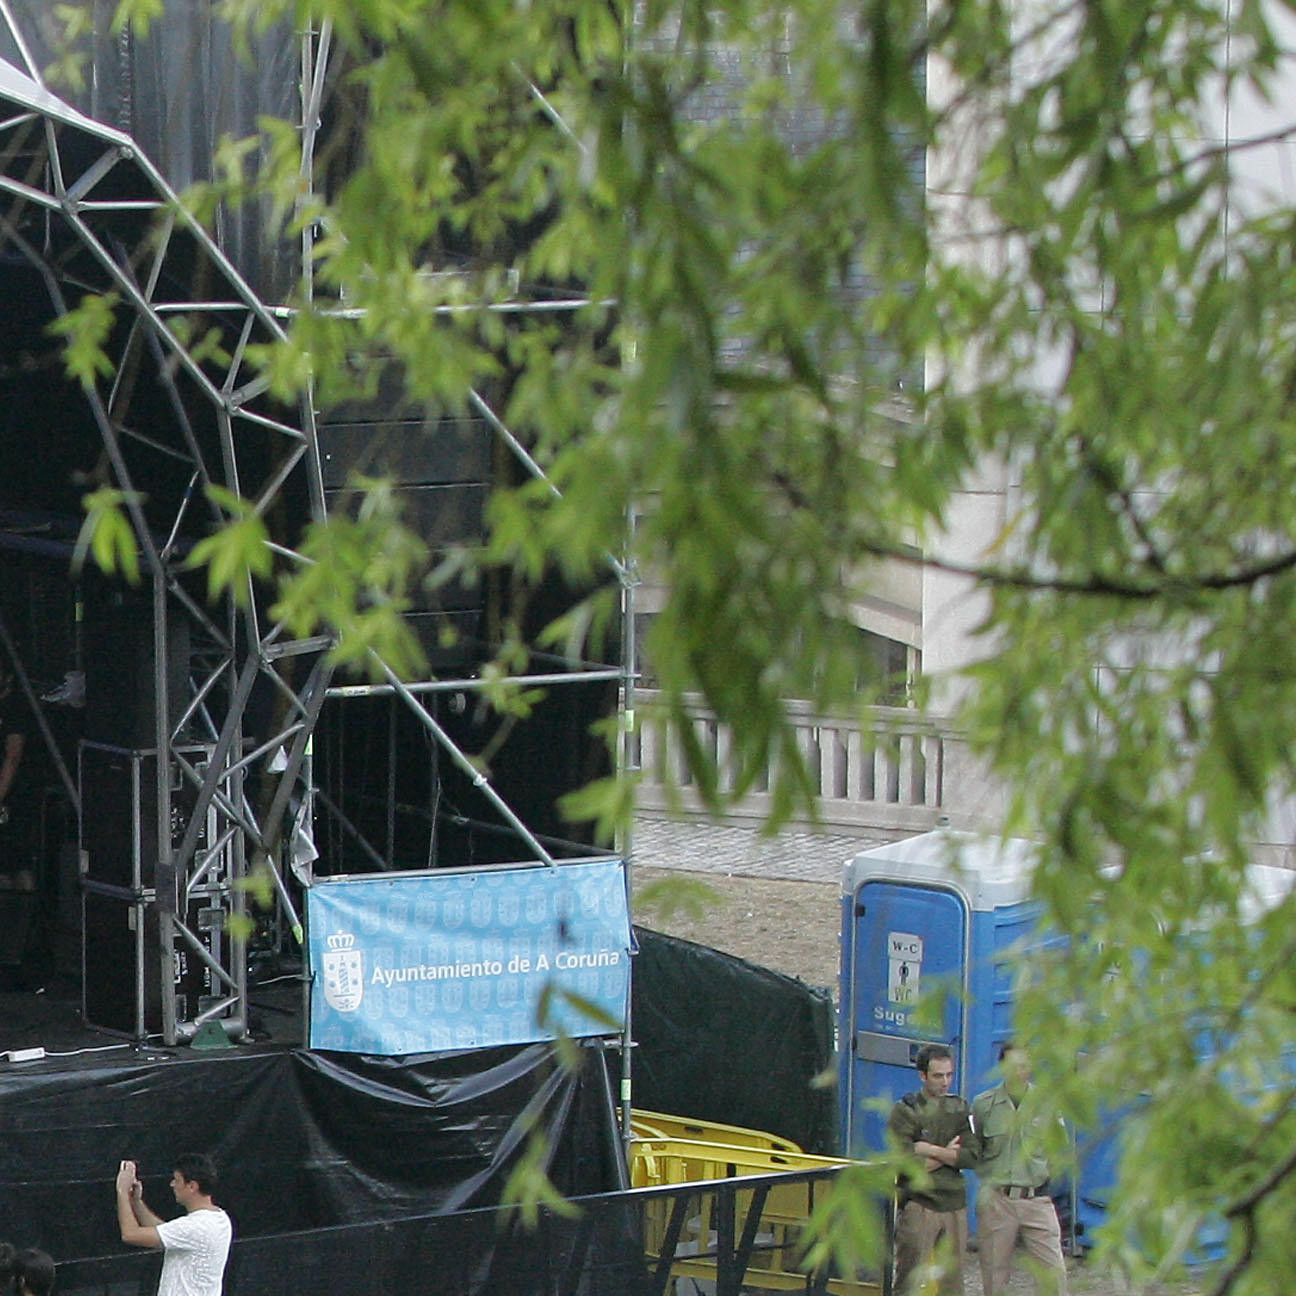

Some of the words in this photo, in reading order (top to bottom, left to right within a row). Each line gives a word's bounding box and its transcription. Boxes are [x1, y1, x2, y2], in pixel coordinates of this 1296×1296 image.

[371, 959, 503, 988] Ayuntamiento
[508, 954, 530, 974] de
[535, 953, 550, 971] A
[555, 949, 620, 970] Coruña
